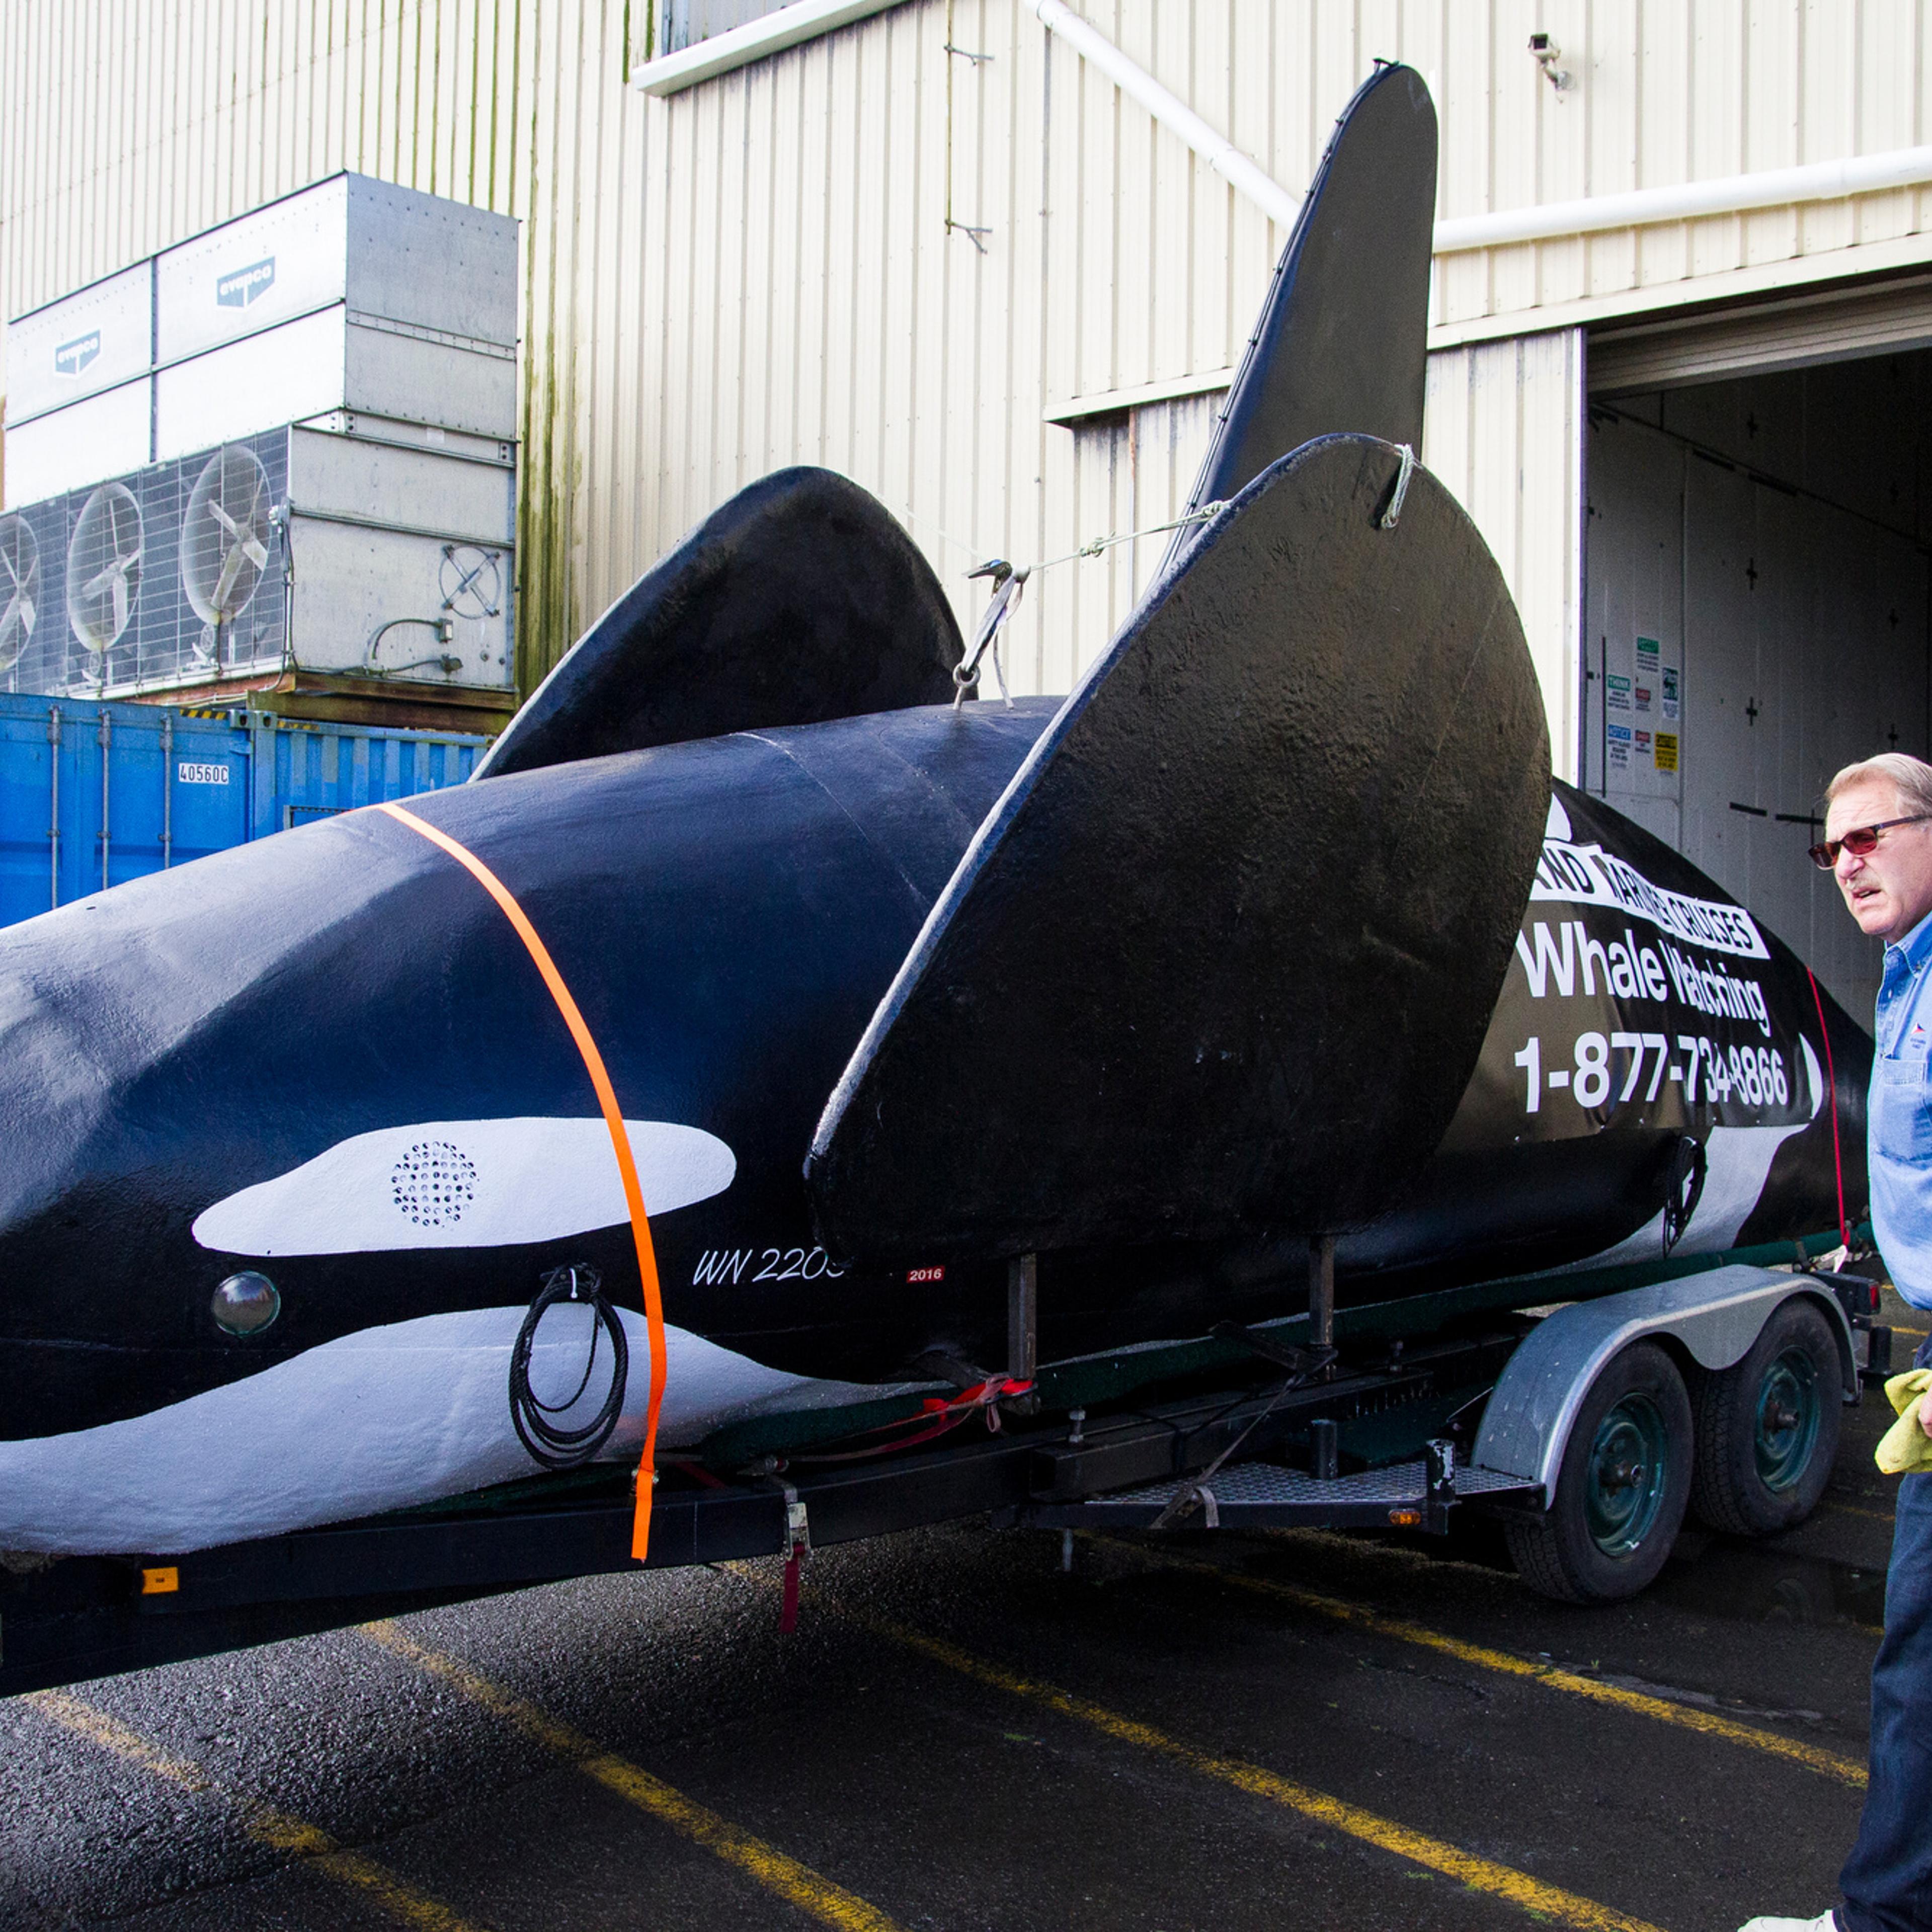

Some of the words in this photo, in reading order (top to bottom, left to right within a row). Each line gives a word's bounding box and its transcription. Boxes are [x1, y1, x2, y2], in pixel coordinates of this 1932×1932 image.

[220, 264, 272, 305] evapco
[1668, 897, 1753, 949] CRUISES
[1515, 921, 1667, 1002] Whale
[1658, 939, 1771, 1037] Watching
[1514, 1031, 1788, 1113] 1-877-734-8866
[693, 1249, 753, 1285] WN
[909, 1268, 942, 1281] 2016
